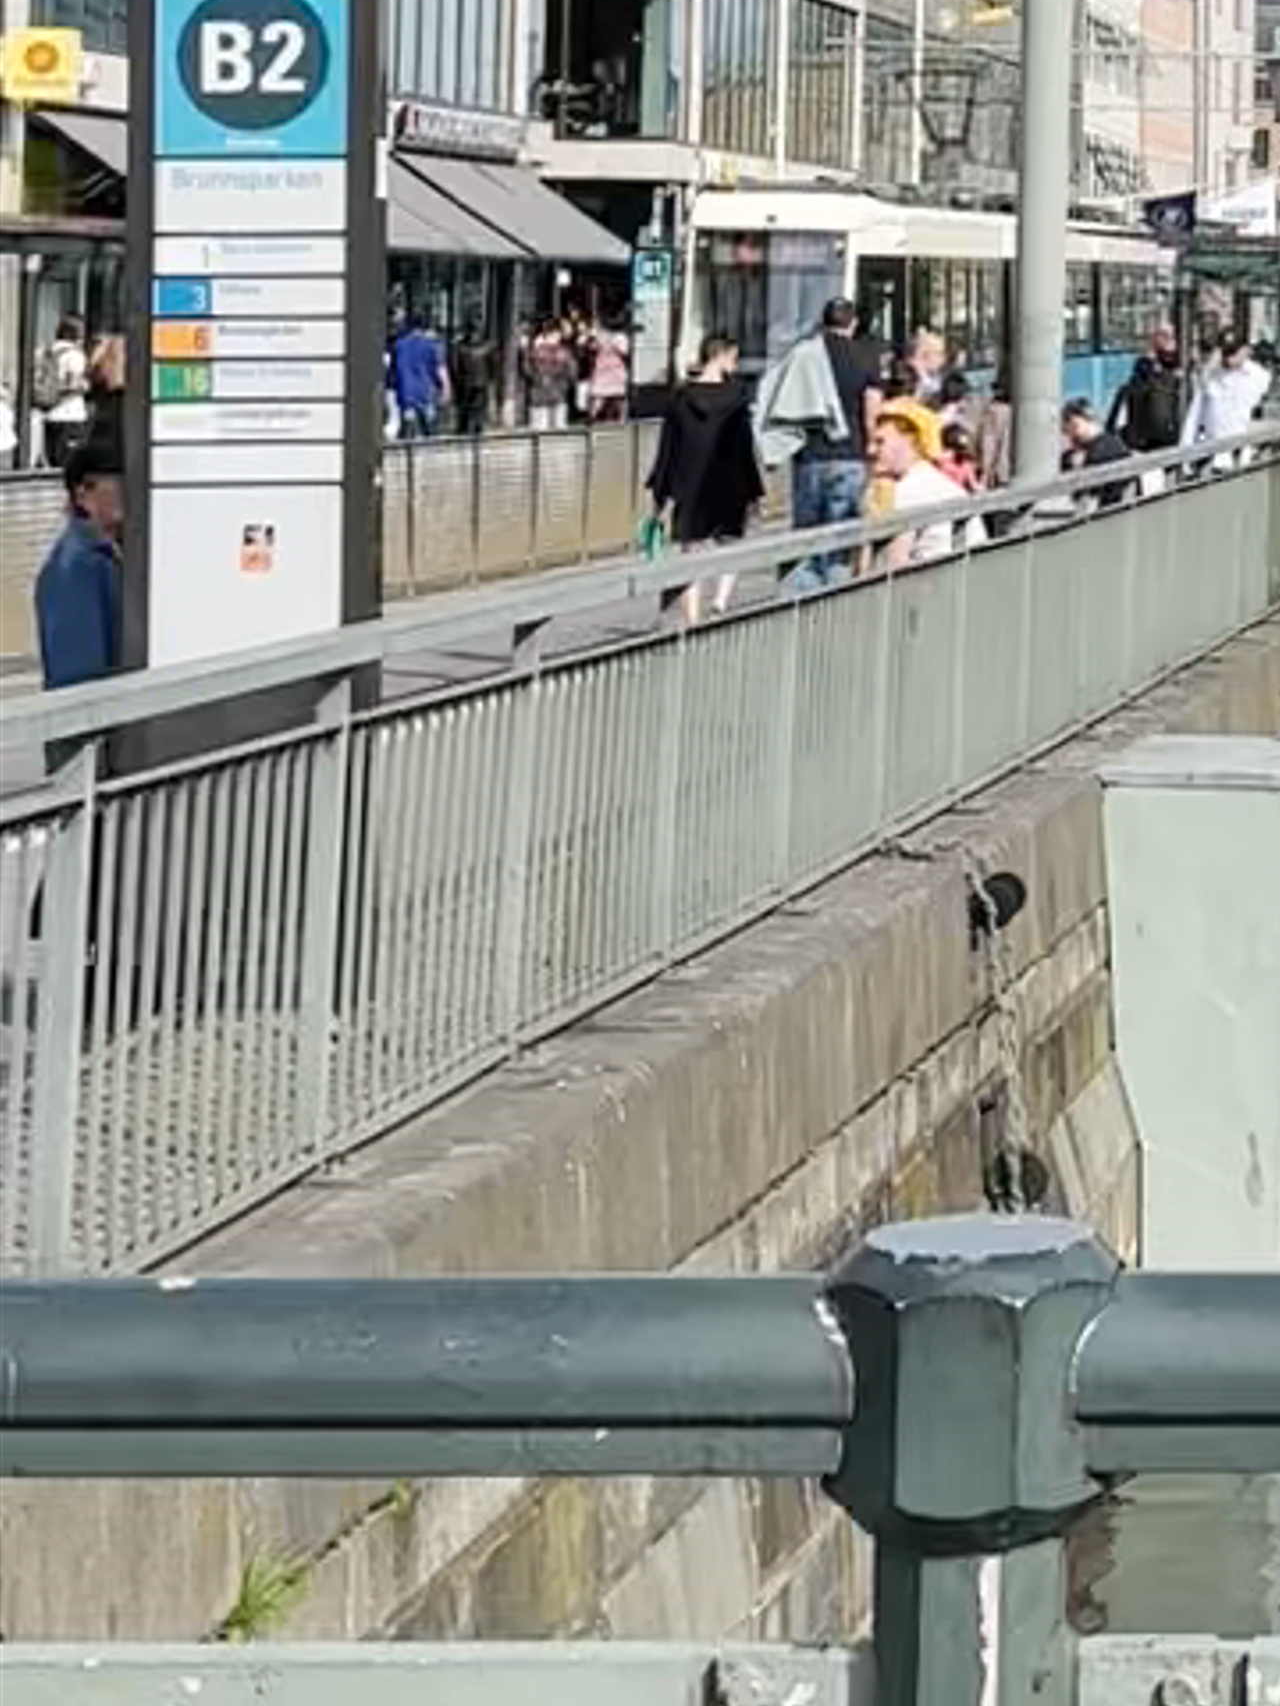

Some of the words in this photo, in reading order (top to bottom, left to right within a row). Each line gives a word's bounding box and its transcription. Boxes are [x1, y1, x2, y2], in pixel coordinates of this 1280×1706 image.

[202, 20, 307, 93] B2
[193, 285, 206, 312] 3
[194, 324, 209, 351] 6
